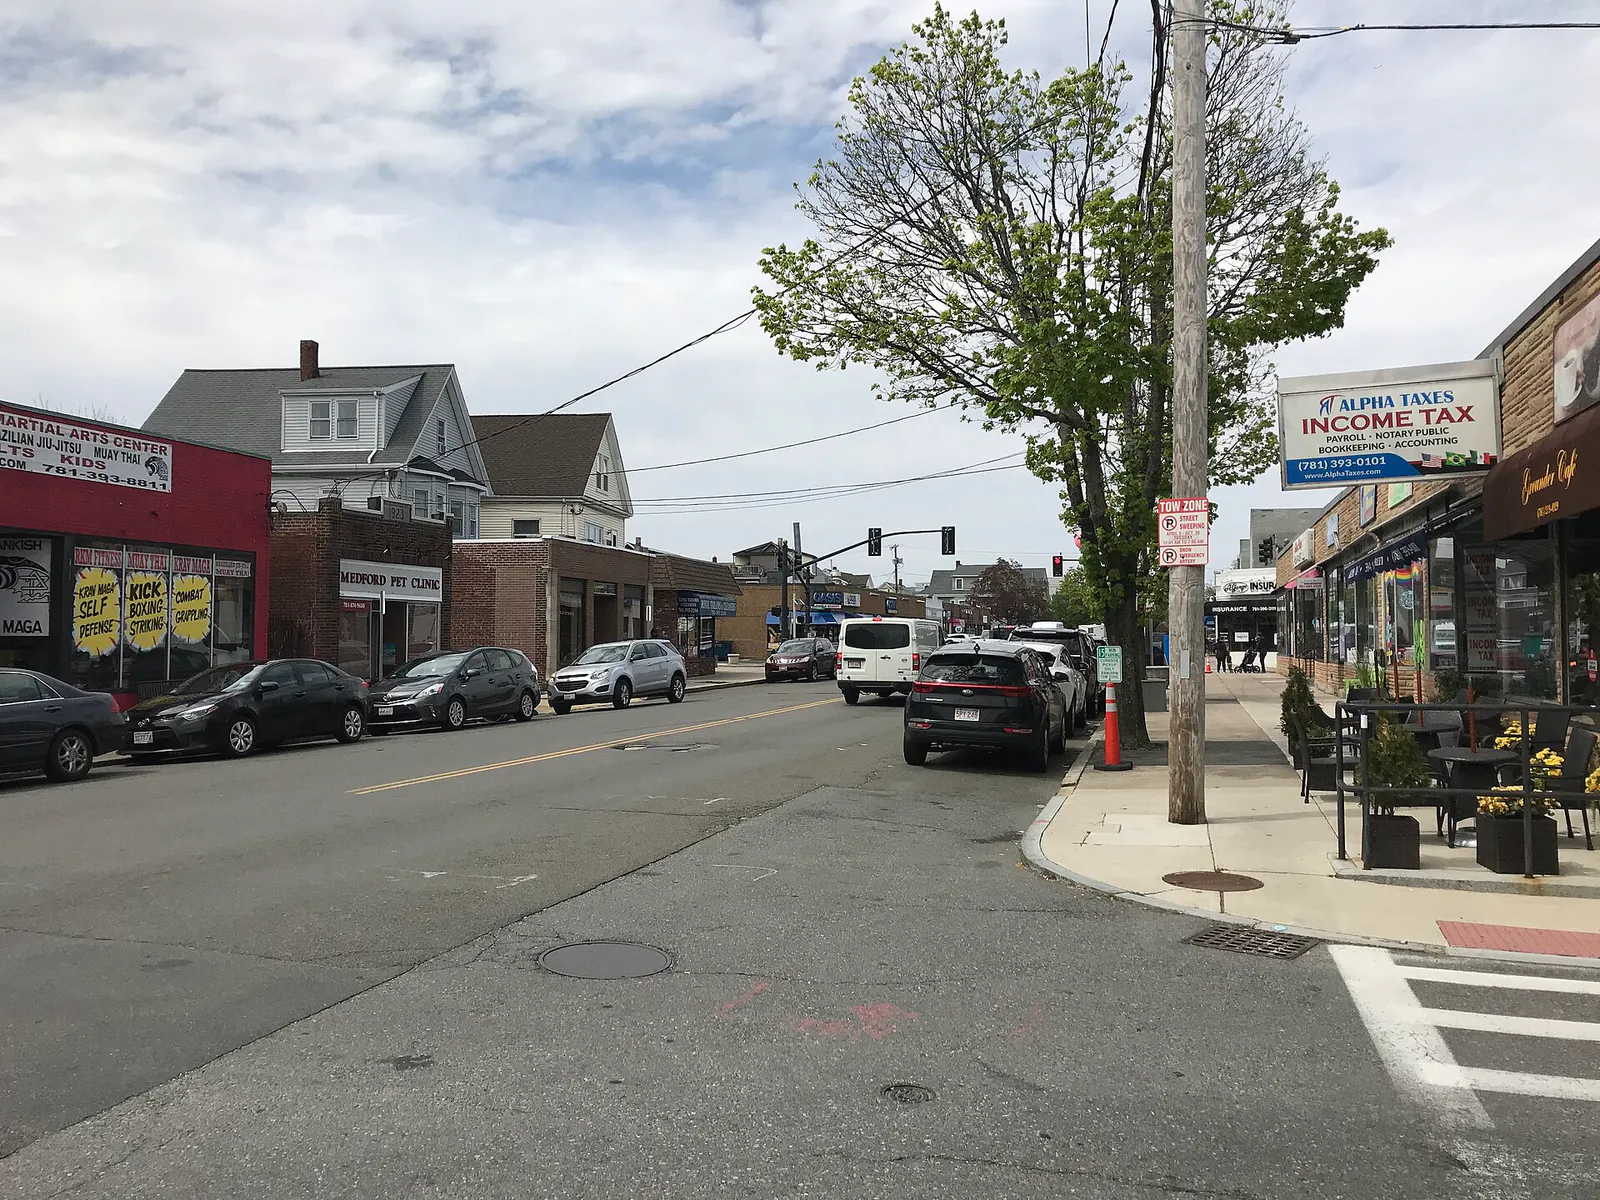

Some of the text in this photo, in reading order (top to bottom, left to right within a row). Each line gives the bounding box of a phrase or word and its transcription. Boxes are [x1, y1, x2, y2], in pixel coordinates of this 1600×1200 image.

[1340, 390, 1454, 412] ALPHA TAXES
[1303, 405, 1475, 435] INCOME TAX
[70, 428, 109, 445] ARTS
[113, 437, 168, 456] CENTER
[1326, 427, 1450, 443] PAYROLL NOTARY PUBLIC
[37, 436, 81, 454] JIU-JITSU
[94, 447, 119, 462] MUAY
[121, 451, 141, 465] THAI
[1318, 437, 1458, 454] BOOKKEEPING ACCOUNTING
[60, 454, 106, 470] KIDS
[1298, 456, 1387, 472] (781) 393-0101
[43, 463, 167, 491] 781-393-8811
[1304, 468, 1381, 480] www.AlphaTaxes.com
[1160, 499, 1207, 512] TOW ZONE
[94, 550, 122, 567] FITNESS
[127, 553, 168, 570] MUAY THAI
[174, 558, 211, 573] KRAV MAGA
[1467, 553, 1496, 564] INCOM
[340, 571, 440, 590] MEDFORD PET CLINIC
[79, 583, 115, 599] KRAV MAGA
[130, 581, 162, 600] KICK
[176, 588, 204, 603] COMBAT
[813, 592, 842, 602] OASIS
[79, 596, 108, 619] SELF
[129, 599, 163, 618] BOXING
[1468, 597, 1497, 608] INCOM
[175, 608, 208, 623] GRAPPLING
[1476, 608, 1493, 619] TAX
[3, 620, 42, 633] MAGA
[79, 619, 114, 638] DEFENSE
[129, 617, 164, 636] STRIKING
[1469, 639, 1498, 649] INCOM
[1478, 651, 1494, 661] TAX
